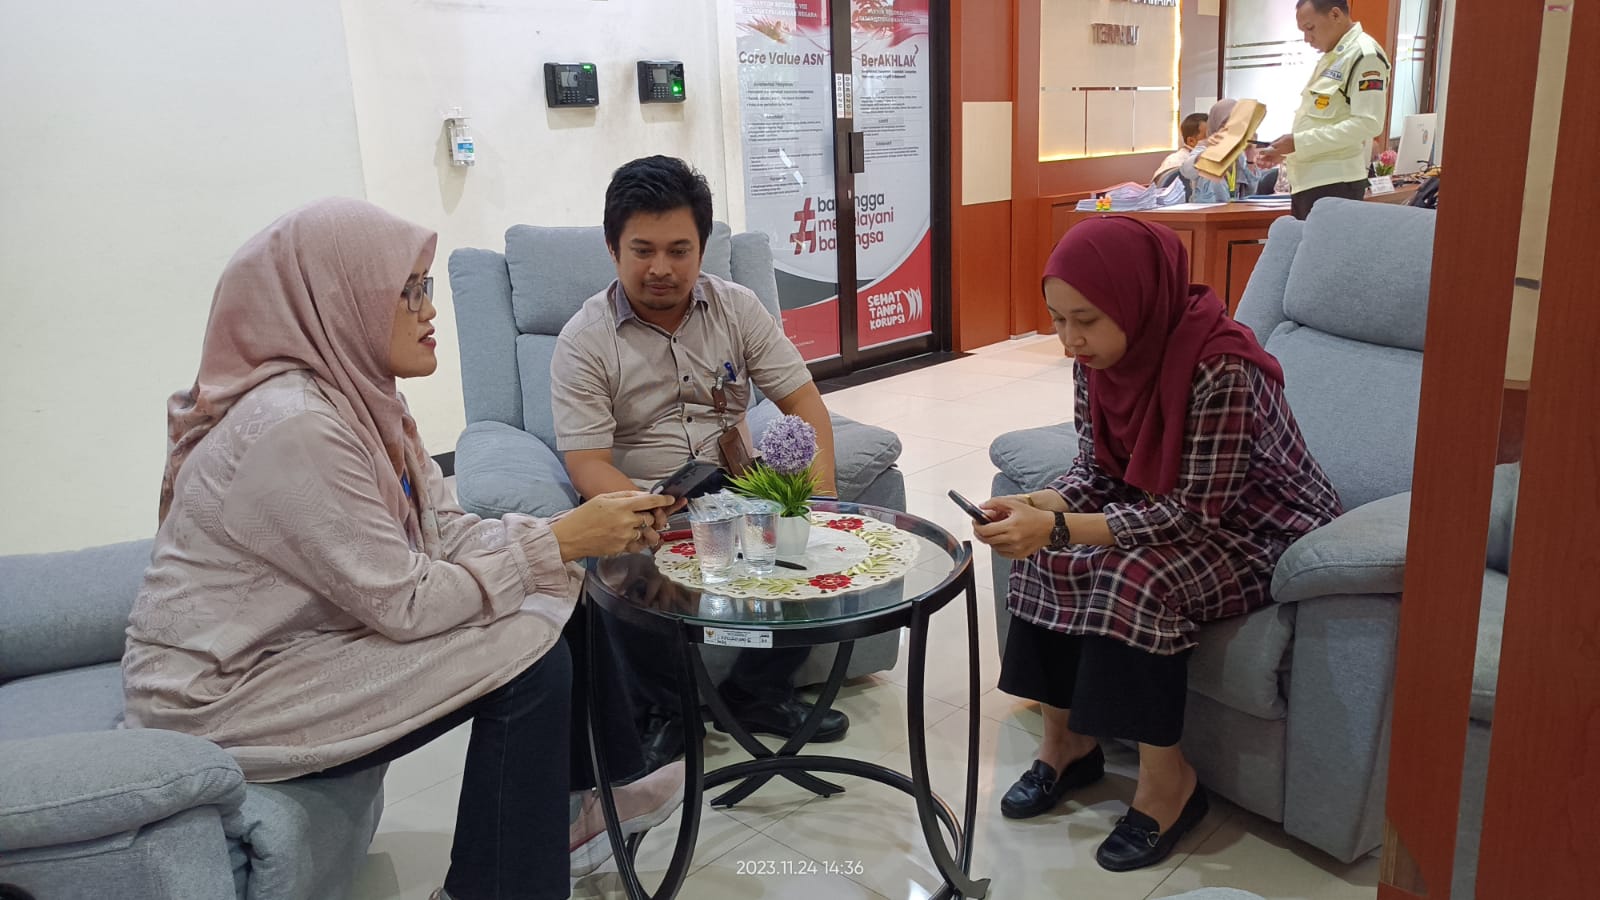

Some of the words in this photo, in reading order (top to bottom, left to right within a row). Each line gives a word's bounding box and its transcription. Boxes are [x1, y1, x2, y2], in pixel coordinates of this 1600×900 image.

[739, 50, 766, 65] Core
[769, 51, 800, 65] Value
[803, 52, 824, 66] ASN
[861, 53, 916, 67] BerAKHLAK
[867, 290, 901, 307] SEHAT
[869, 302, 904, 319] TANPA
[870, 314, 905, 330] KORUPSI
